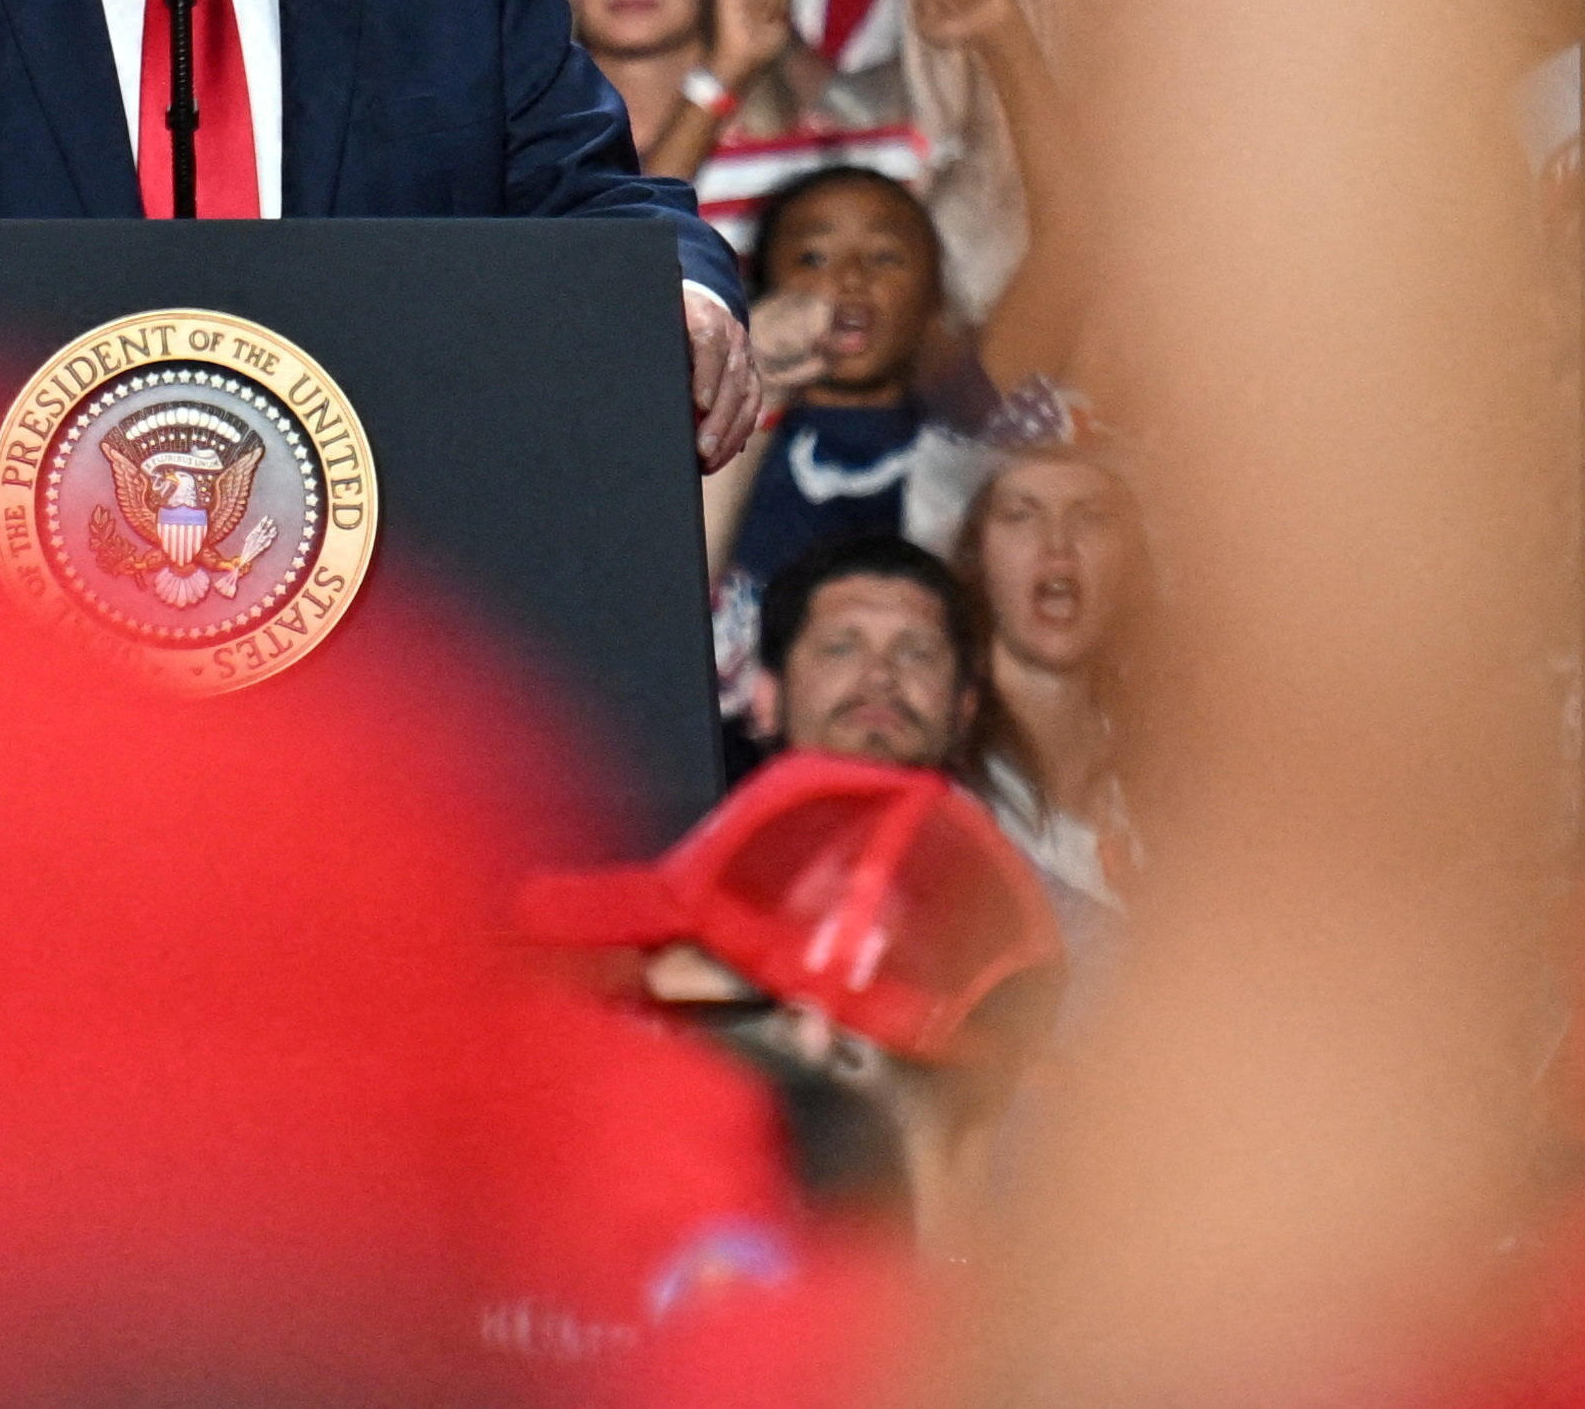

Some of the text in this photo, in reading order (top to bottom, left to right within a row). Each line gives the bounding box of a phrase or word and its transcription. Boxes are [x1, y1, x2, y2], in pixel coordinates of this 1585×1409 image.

[188, 329, 226, 352] OF
[231, 337, 281, 376] THE
[1, 324, 177, 490] PRESIDENT
[288, 372, 364, 531] UNITED
[3, 504, 32, 558] THE
[212, 565, 346, 679] STATES
